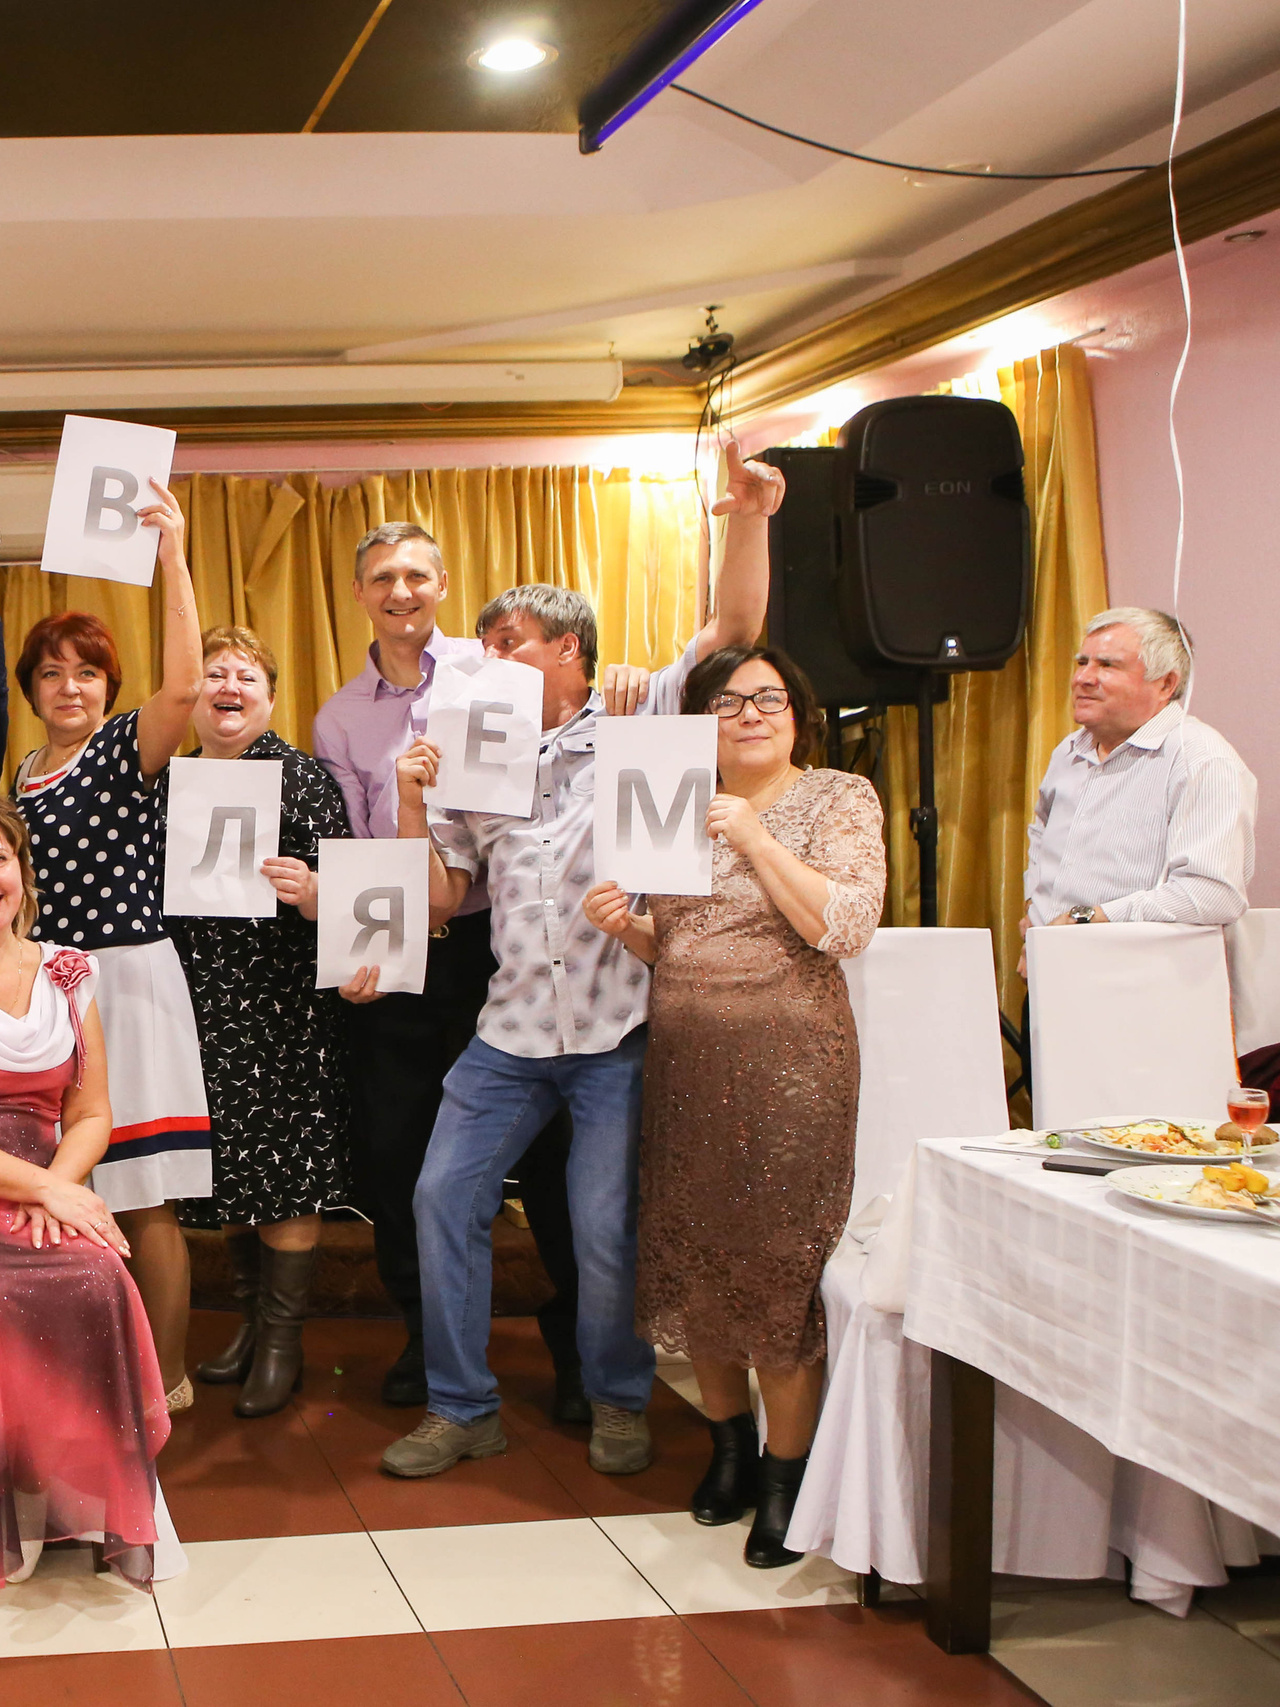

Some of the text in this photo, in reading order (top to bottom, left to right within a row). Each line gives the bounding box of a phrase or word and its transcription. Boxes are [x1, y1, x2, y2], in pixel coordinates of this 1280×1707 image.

[83, 464, 140, 541] В
[925, 480, 971, 496] EON
[464, 699, 515, 775] Е
[190, 805, 257, 881] Л
[616, 767, 712, 855] М
[348, 885, 405, 960] Я
